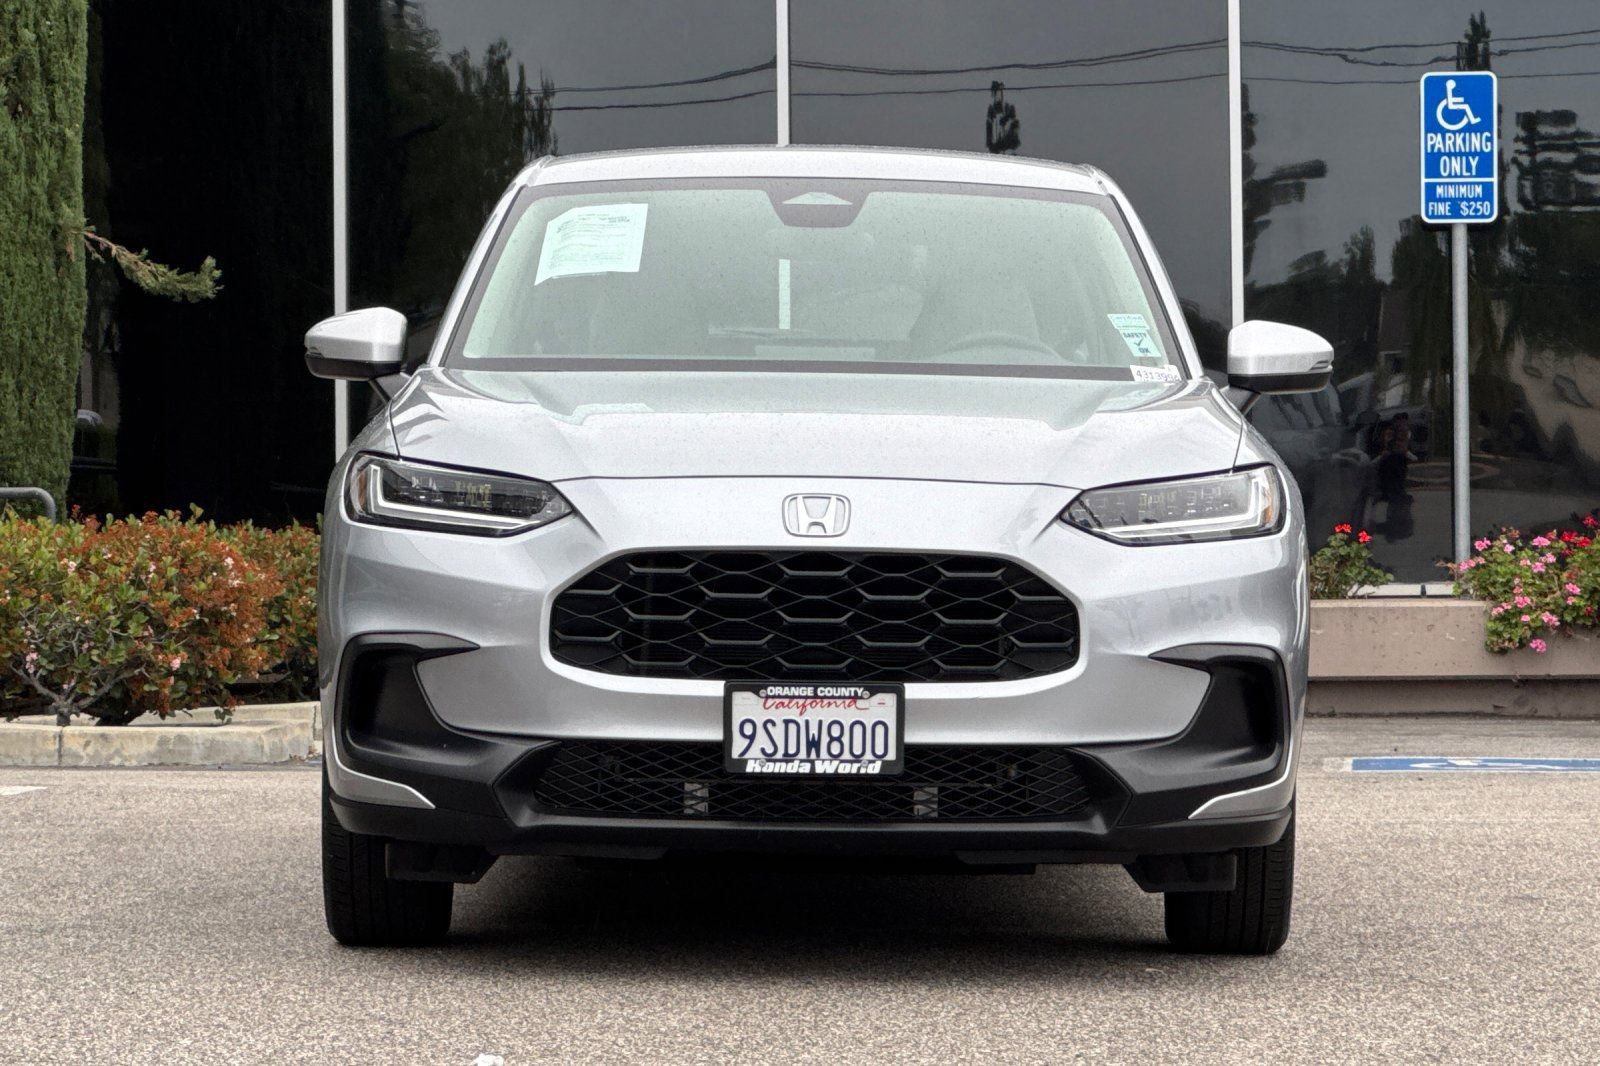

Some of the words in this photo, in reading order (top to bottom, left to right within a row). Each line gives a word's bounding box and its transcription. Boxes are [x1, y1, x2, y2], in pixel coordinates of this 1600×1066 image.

[1427, 132, 1492, 153] PARKING
[1440, 156, 1479, 177] ONLY
[1436, 185, 1482, 198] MINIMUM
[1428, 202, 1451, 216] FINE
[1459, 201, 1490, 216] $250
[767, 686, 814, 697] ORANGE
[817, 686, 864, 697] COUNTY
[763, 698, 869, 716] California
[737, 718, 889, 759] 9SDW800
[745, 759, 811, 773] Honda
